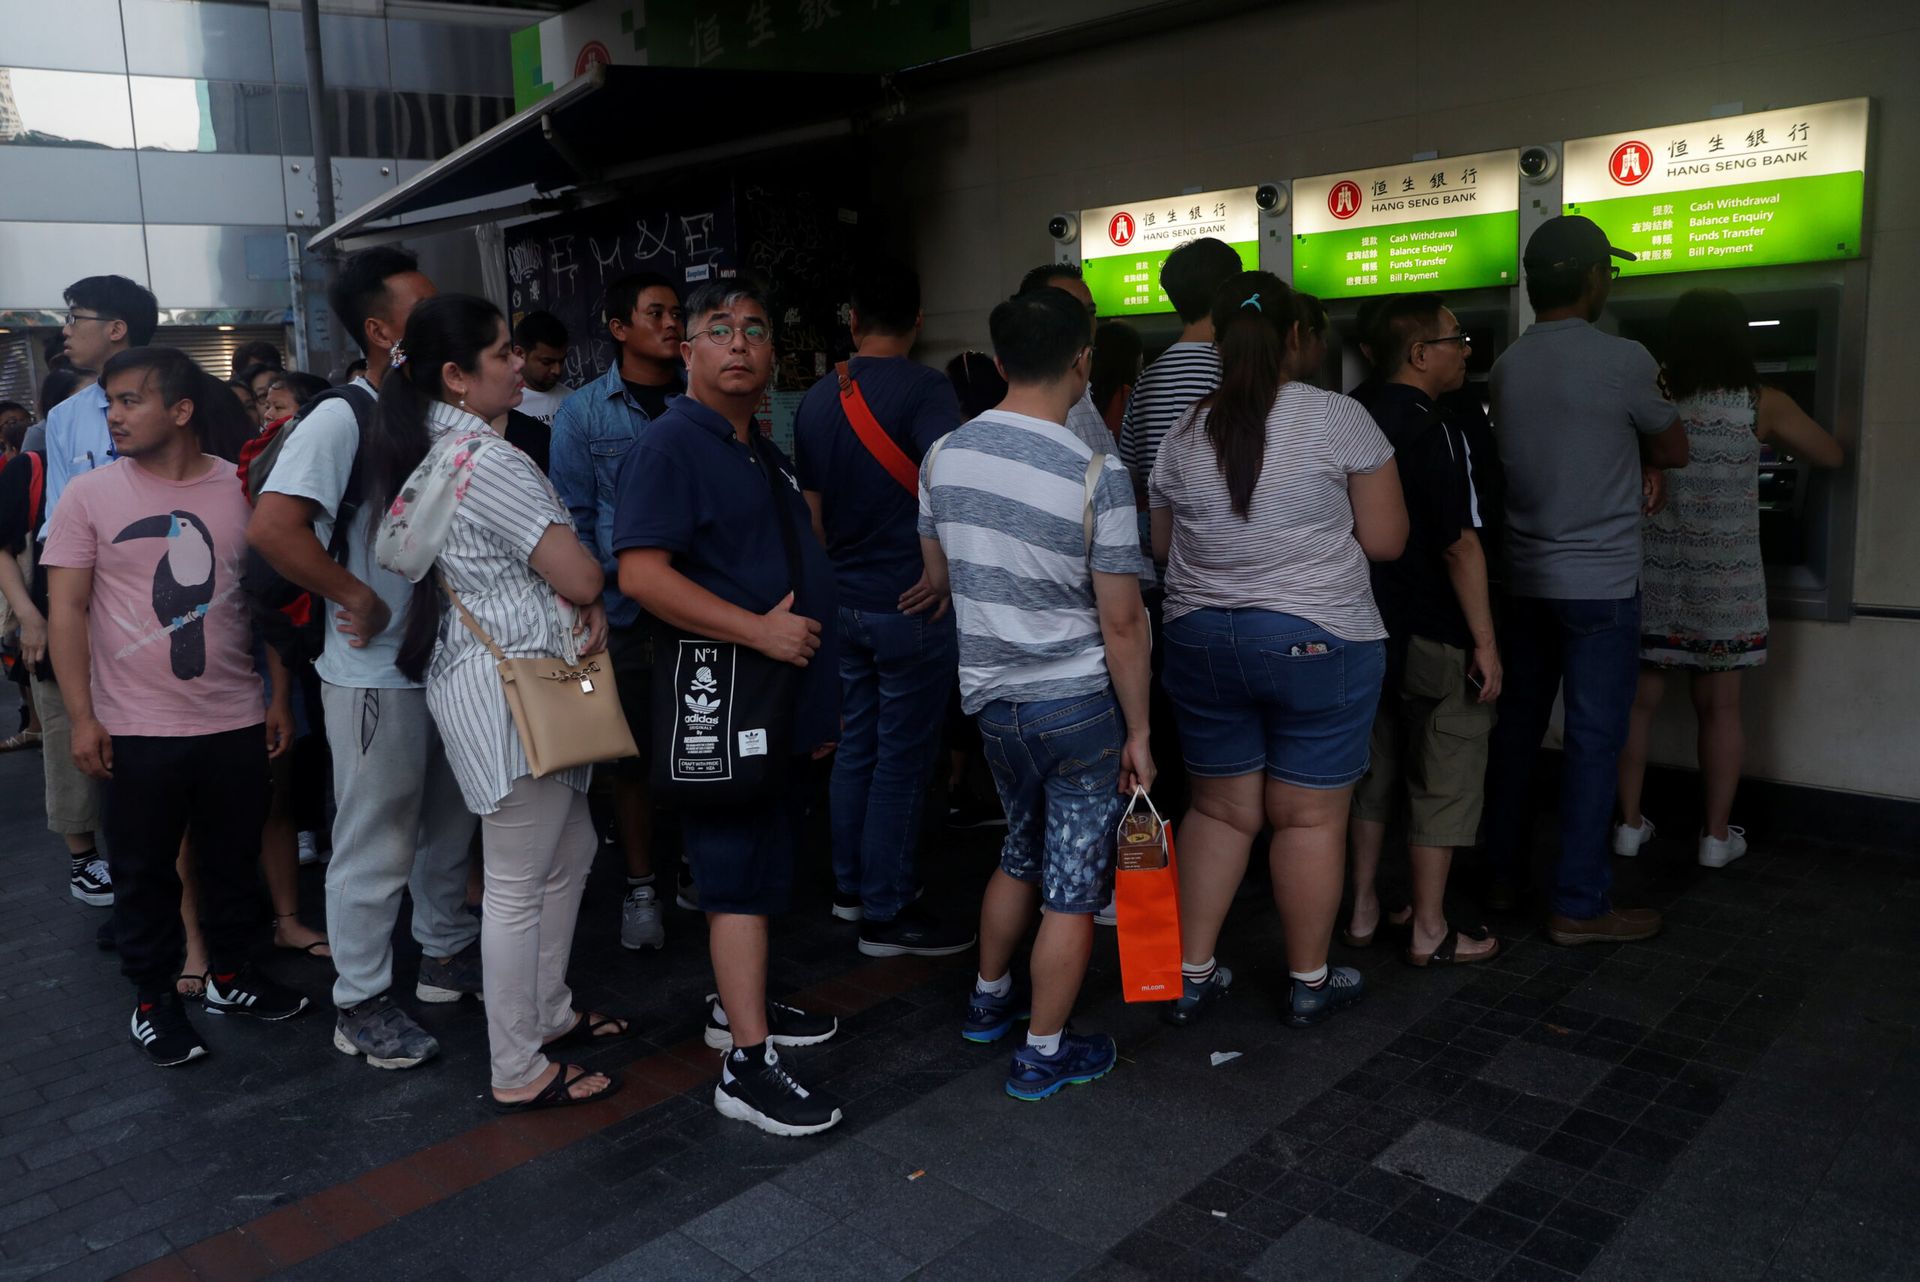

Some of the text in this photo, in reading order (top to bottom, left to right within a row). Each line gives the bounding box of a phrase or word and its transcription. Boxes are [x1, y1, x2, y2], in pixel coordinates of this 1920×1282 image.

[1667, 122, 1810, 159] 恒生銀行
[1667, 151, 1808, 177] HANG SENG BANK
[1371, 168, 1477, 196] 恒生銀行
[1372, 192, 1476, 213] HANG SENG BANK
[1690, 193, 1780, 212] Cash Withdrawal
[1143, 203, 1226, 226] 恒生銀行
[1689, 209, 1774, 228] Balance Enquiry
[1144, 225, 1226, 240] HANG SENG BANK
[1390, 229, 1457, 243] Cash Withdrawal
[1689, 225, 1765, 242] Funds Transfer
[1390, 243, 1453, 257] Balance Enquiry
[1688, 243, 1753, 259] Bill Payment
[1390, 257, 1447, 270] Funds Transfer
[1390, 271, 1438, 283] Bill Payment
[684, 714, 719, 725] adidas
